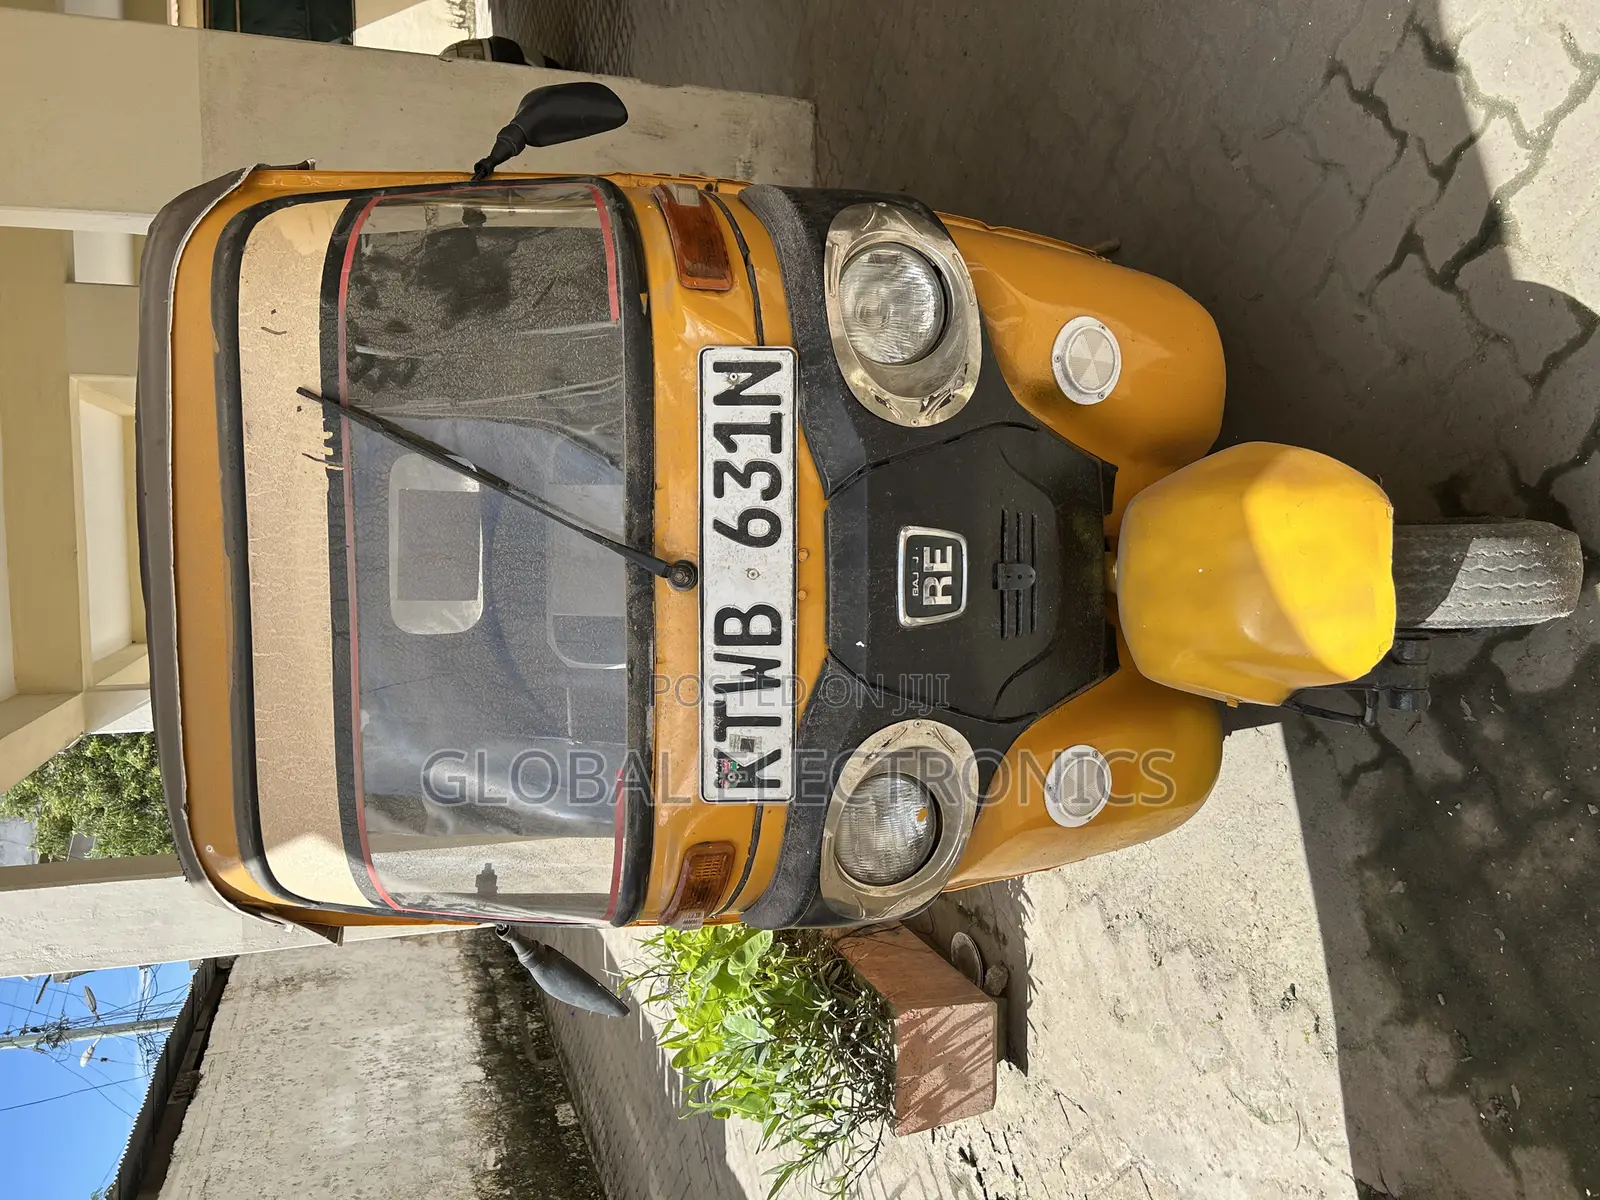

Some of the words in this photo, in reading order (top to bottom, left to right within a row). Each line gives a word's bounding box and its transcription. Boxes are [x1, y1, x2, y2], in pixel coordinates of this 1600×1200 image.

[713, 361, 782, 549] 631N
[922, 545, 953, 606] RE
[713, 604, 782, 789] KTWB
